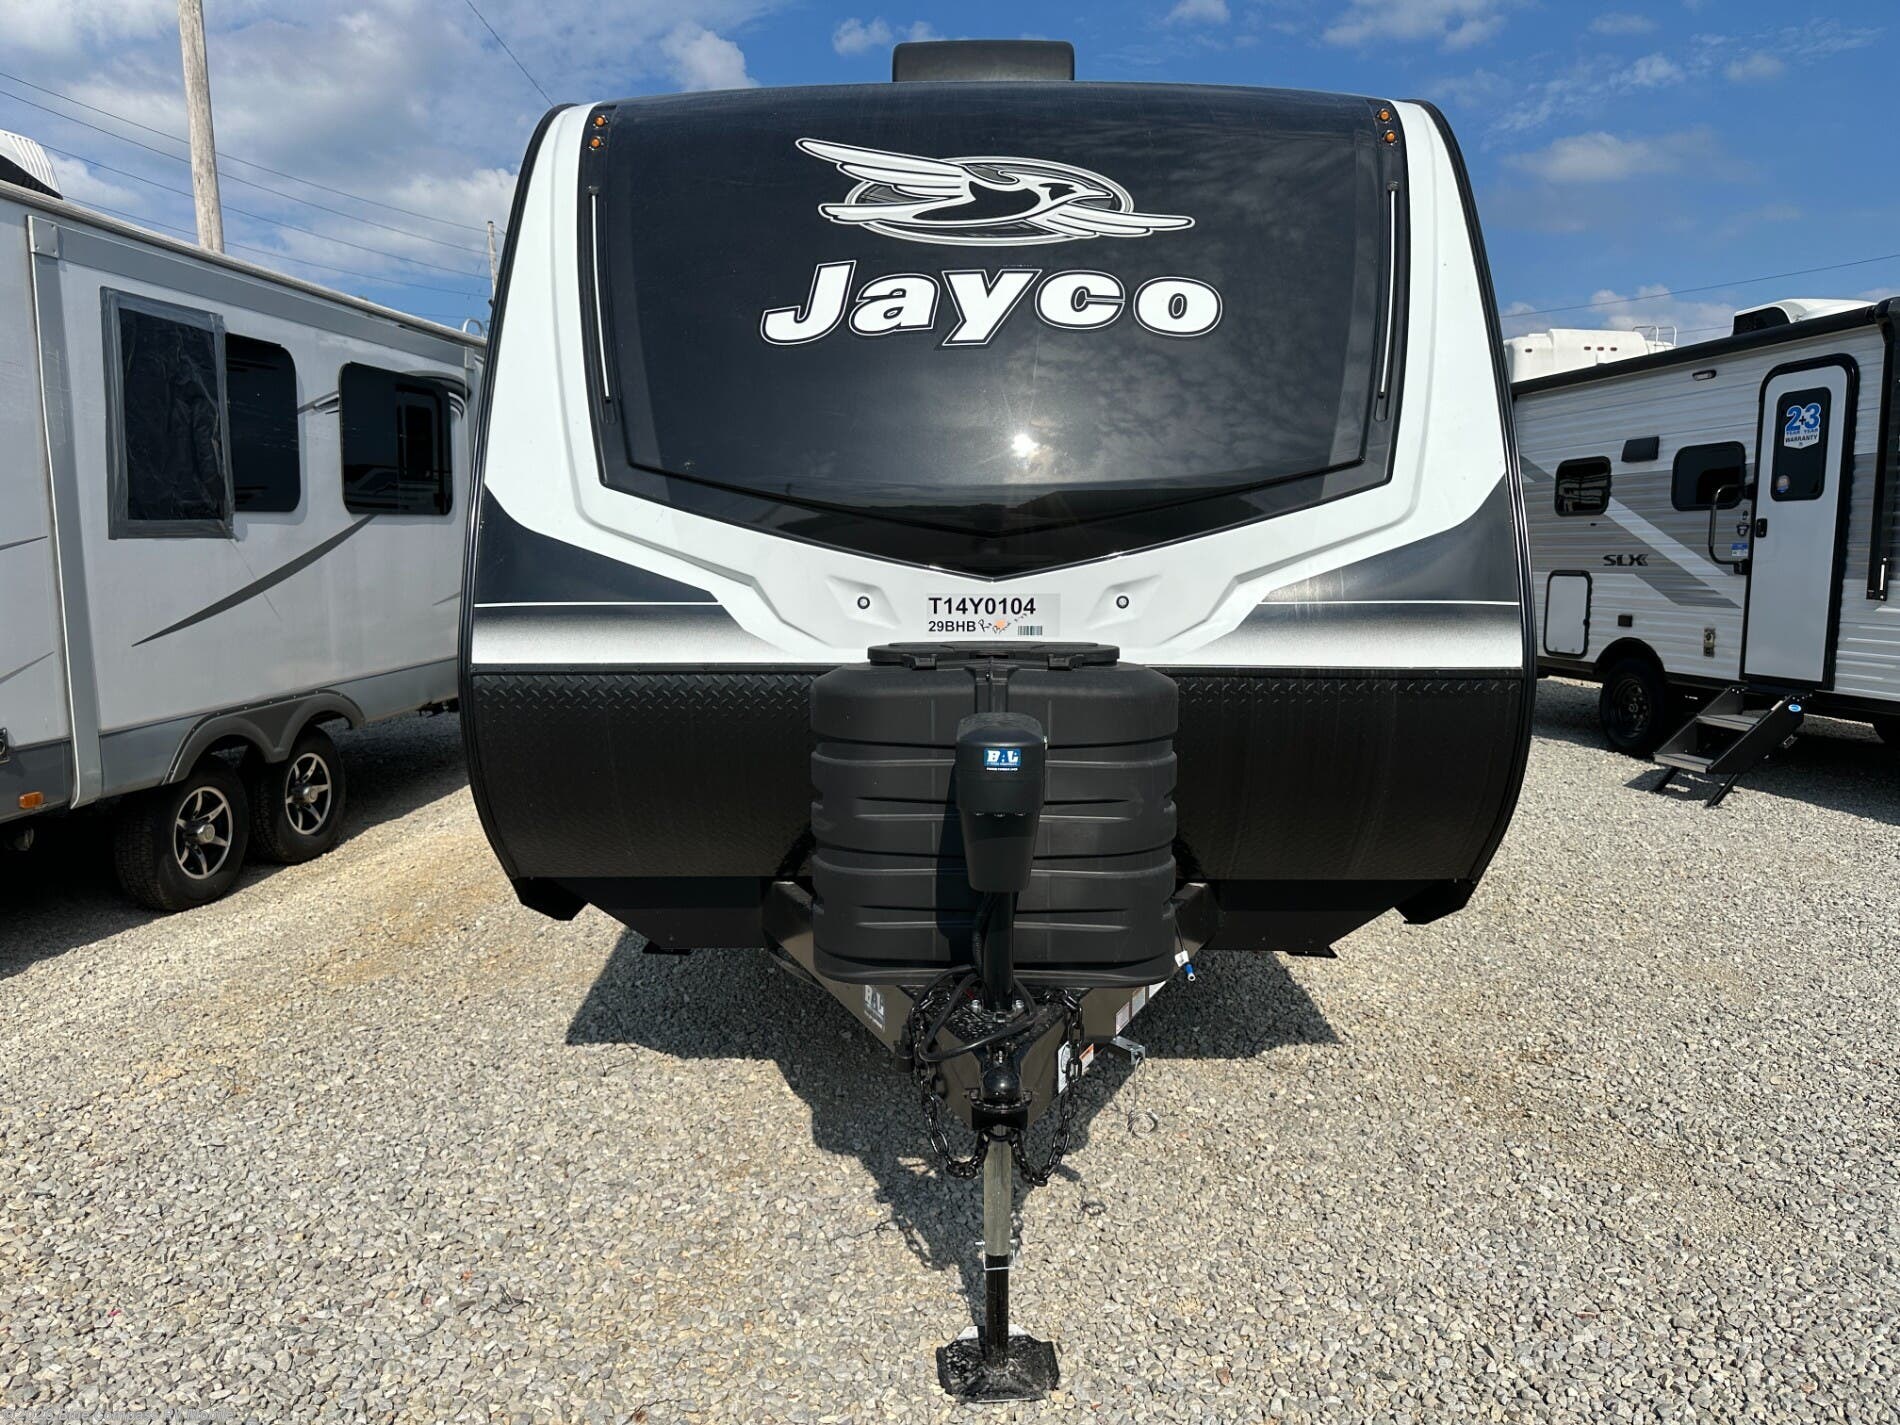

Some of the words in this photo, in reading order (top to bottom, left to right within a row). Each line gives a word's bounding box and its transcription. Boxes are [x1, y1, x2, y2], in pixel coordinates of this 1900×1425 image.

[760, 260, 1222, 346] Jayco
[928, 597, 1036, 615] T14Y0104
[928, 620, 976, 632] 29BHB
